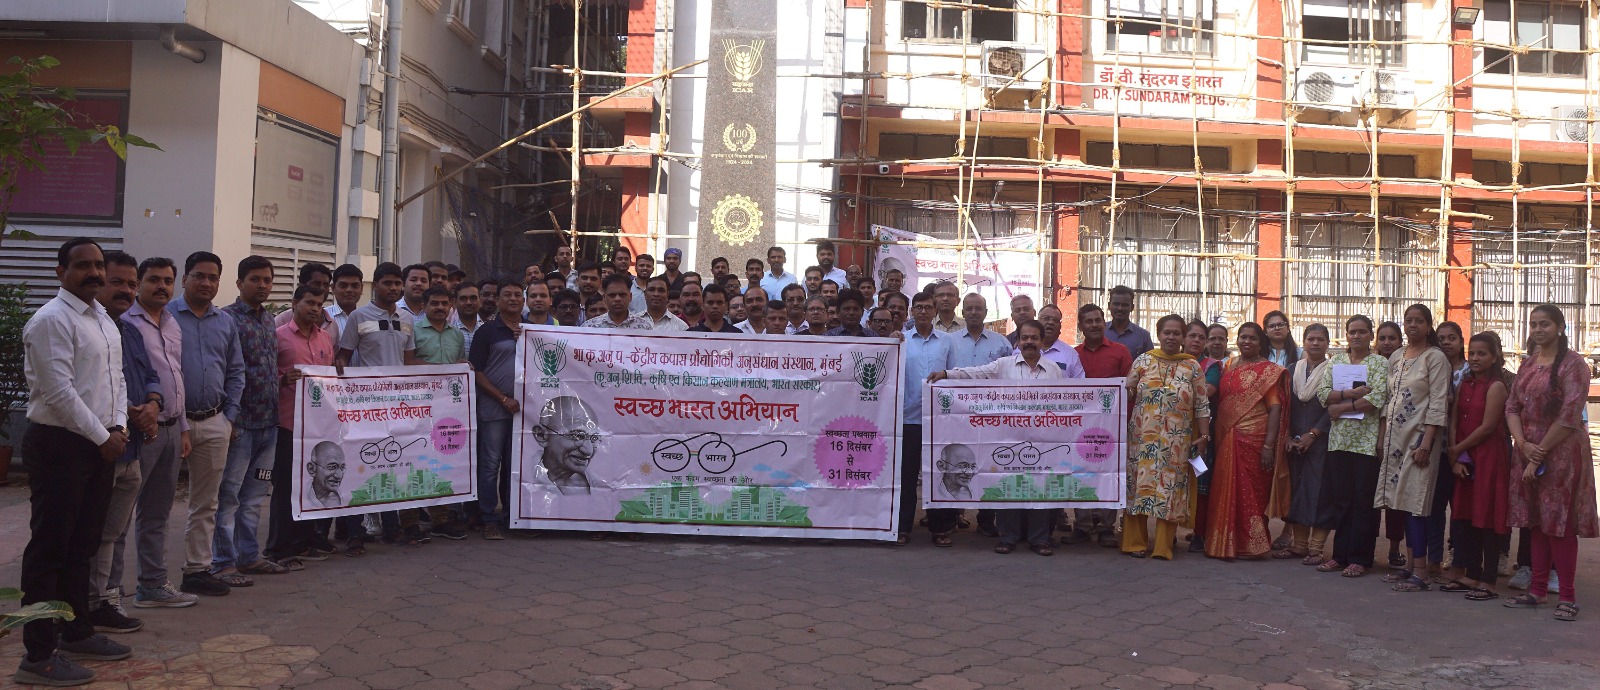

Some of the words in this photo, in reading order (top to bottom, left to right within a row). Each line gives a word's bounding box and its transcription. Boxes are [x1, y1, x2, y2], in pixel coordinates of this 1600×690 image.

[1139, 70, 1179, 88] सुंदरम
[732, 129, 748, 138] 100
[660, 352, 687, 366] कपास
[736, 353, 779, 374] अनुसंधान
[782, 353, 817, 372] संस्थान,
[820, 353, 843, 376] मुंबई
[650, 370, 667, 389] कृषि
[682, 371, 708, 387] किसान
[772, 379, 790, 390] भारत
[362, 408, 389, 421] भारत
[390, 401, 432, 420] अभियान
[614, 397, 666, 417] स्वच्छ
[668, 399, 715, 420] भारत
[718, 394, 799, 422] अभियान
[969, 416, 1001, 427] स्वच्छ
[1003, 416, 1032, 427] भारत
[1033, 411, 1082, 427] अभियान
[830, 441, 843, 451] 16
[847, 441, 873, 452] दिसंबर
[705, 454, 727, 462] भारत
[847, 454, 854, 466] से
[828, 469, 841, 479] 31
[846, 469, 872, 480] दिसंबर
